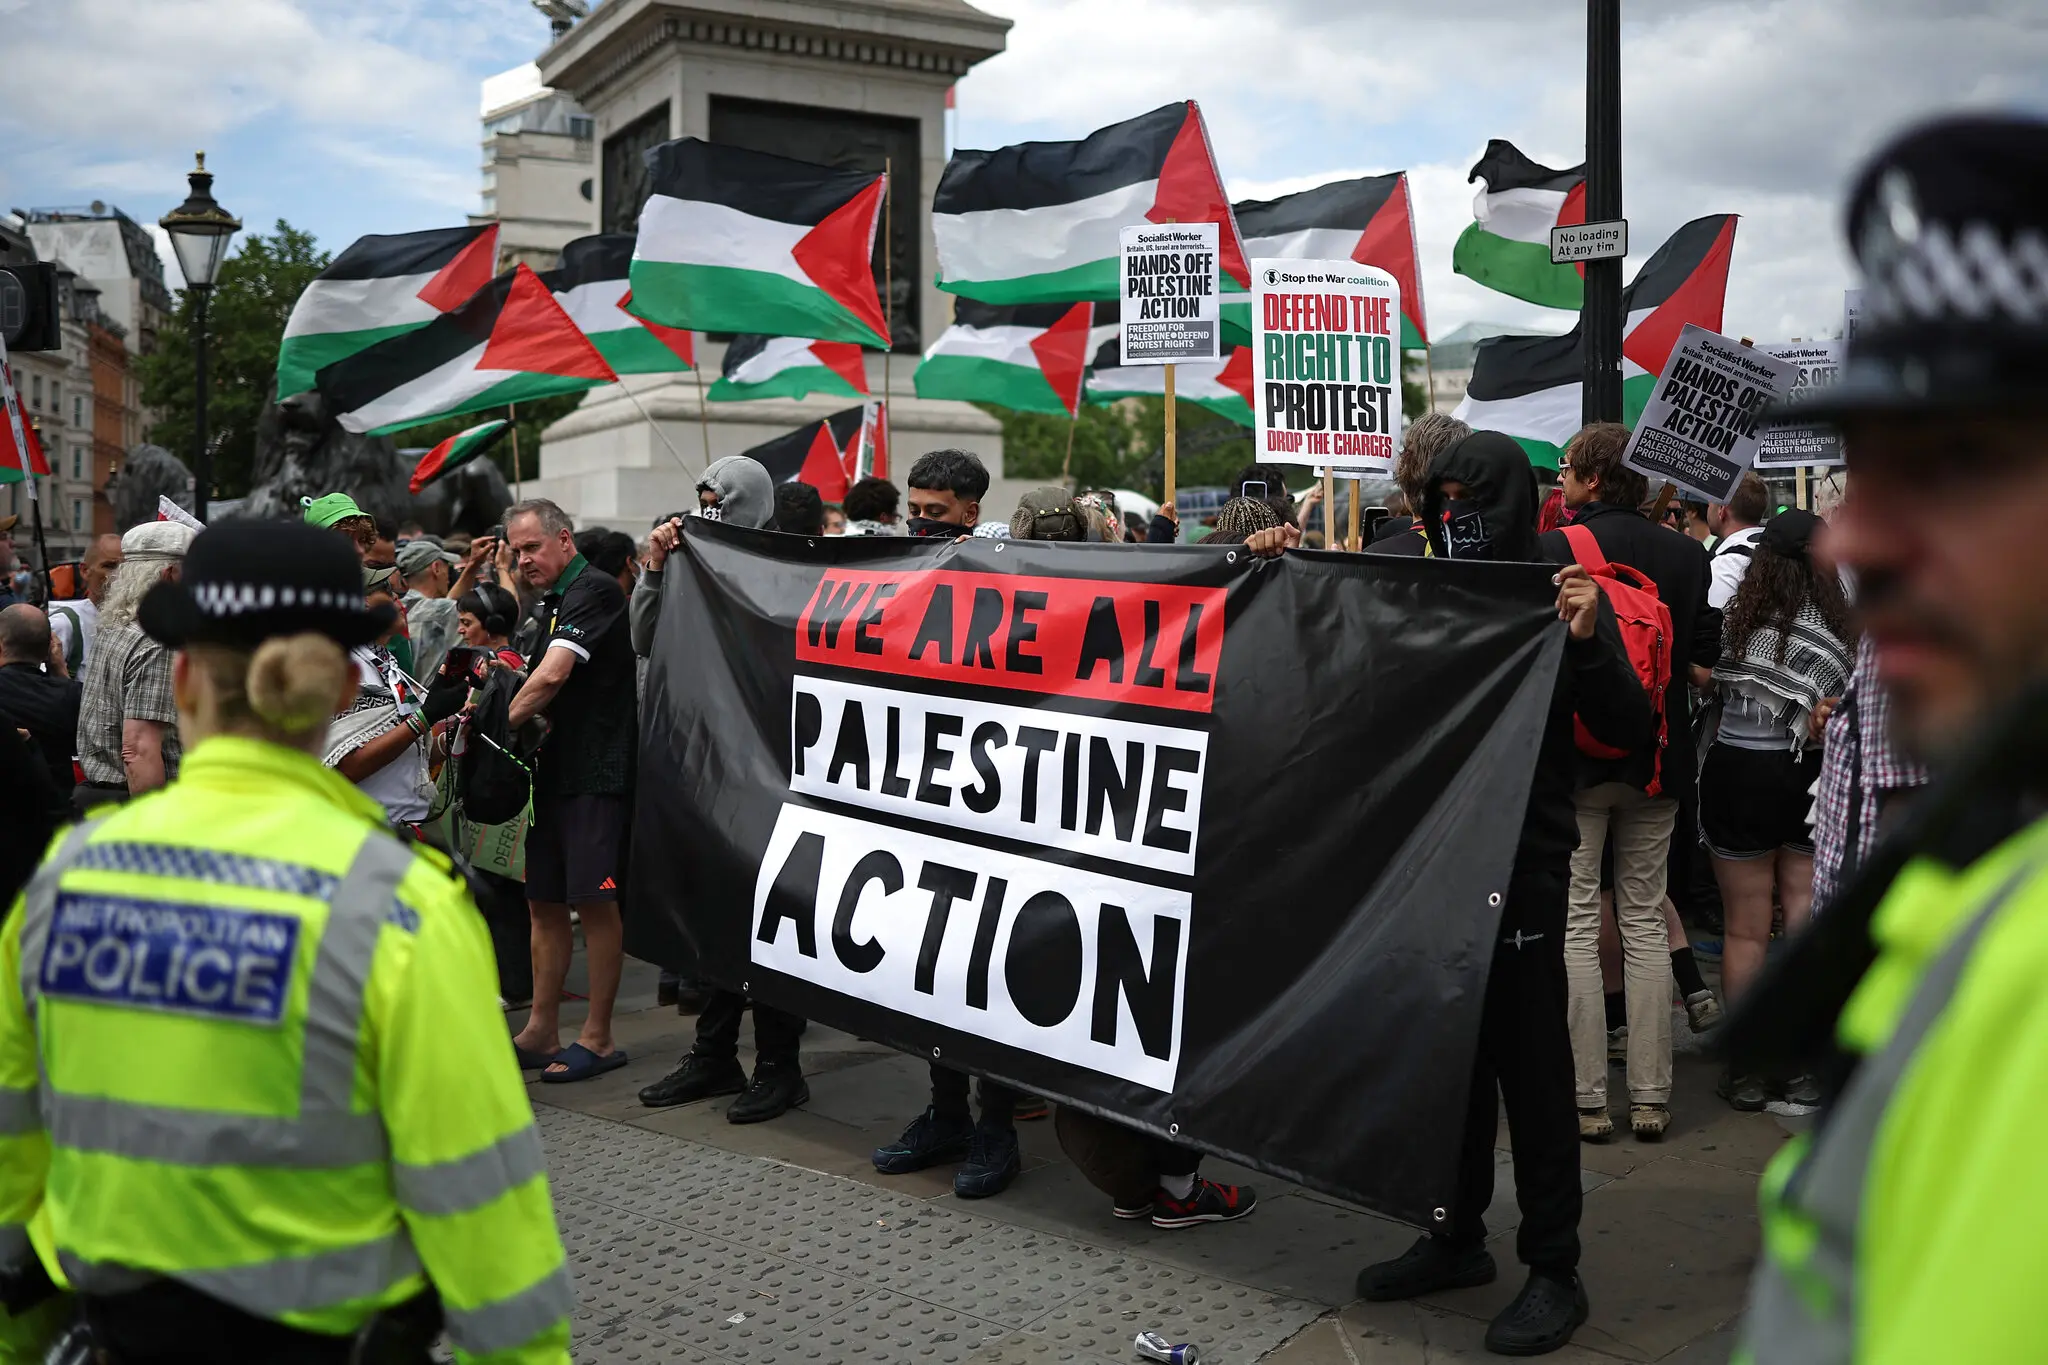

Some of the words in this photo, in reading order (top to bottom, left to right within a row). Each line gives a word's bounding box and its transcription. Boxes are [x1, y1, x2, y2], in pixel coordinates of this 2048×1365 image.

[1137, 233, 1172, 243] Socialist
[1172, 232, 1203, 241] Worker
[1155, 243, 1170, 251] Israel
[1560, 233, 1575, 243] No
[1579, 229, 1619, 241] loading
[1558, 246, 1571, 256] At
[1574, 245, 1593, 255] any
[1127, 253, 1181, 276] HANDS
[1184, 252, 1213, 274] OFF
[1128, 275, 1213, 298] PALESTINE
[1281, 273, 1305, 284] Stop
[1307, 274, 1324, 283] the
[1325, 274, 1346, 283] War
[1347, 276, 1389, 287] coalition
[1140, 297, 1200, 319] ACTION
[1263, 293, 1348, 332] DEFEND
[1350, 295, 1391, 335] THE
[1128, 323, 1167, 333] FREEDOM
[1168, 323, 1185, 331] FOR
[1128, 332, 1170, 341] PALESTINE
[1177, 331, 1209, 340] DEFEND
[1128, 340, 1163, 350] PROTEST
[1164, 340, 1195, 348] RIGHTS
[1129, 350, 1187, 358] socialistworker.co.uk
[1768, 350, 1800, 359] ocialist
[1800, 349, 1829, 358] Worker
[1264, 333, 1353, 382] RIGHT
[1355, 335, 1392, 384] TO
[1700, 340, 1742, 366] Socialist
[1742, 358, 1776, 379] Worker
[1715, 360, 1734, 373] Israel
[1733, 368, 1744, 378] are
[1670, 357, 1740, 402] HANDS
[1737, 386, 1775, 413] OF
[1811, 366, 1839, 388] OFF
[1265, 382, 1392, 434] PROTEST
[1660, 379, 1760, 440] PALESTINE
[1662, 408, 1739, 455] ACTION
[1760, 439, 1800, 447] PALESTINE
[1806, 436, 1836, 445] DEFEND
[1764, 431, 1797, 440] REEDOM
[1798, 430, 1813, 438] FOR
[1267, 430, 1303, 453] DROP
[1306, 432, 1330, 454] THE
[1333, 433, 1392, 459] CHARGES
[1643, 428, 1689, 453] FREEDOM
[1688, 447, 1708, 461] FOR
[1760, 445, 1794, 455] PROTEST
[1794, 444, 1823, 453] RIGHTS
[1635, 445, 1677, 466] PROTEST
[1676, 459, 1710, 481] RIGHTS
[1639, 438, 1688, 462] PALESTINE
[1694, 458, 1731, 481] DEFEND
[806, 579, 902, 656] WE
[908, 584, 1049, 674] ARE
[1075, 596, 1212, 694] ALL
[794, 691, 1201, 854] PALESTINE
[60, 901, 288, 951] METROPOLITAN
[756, 831, 1182, 1062] ACTION
[46, 932, 279, 1011] POLICE
